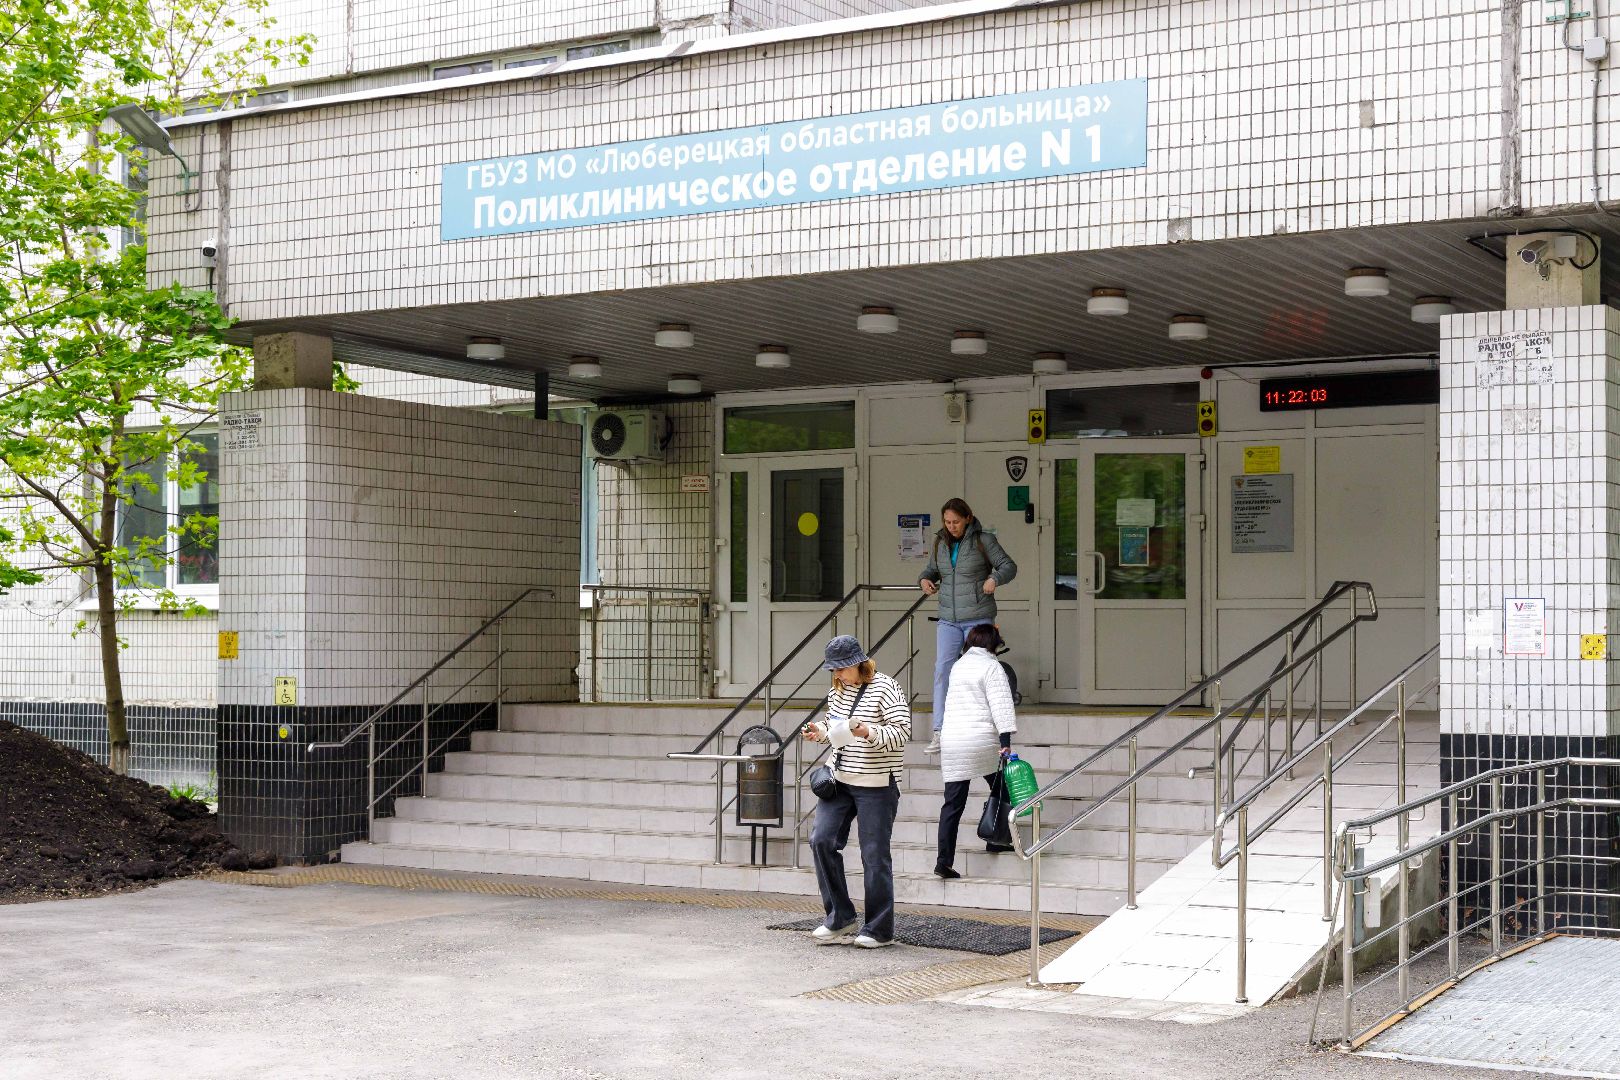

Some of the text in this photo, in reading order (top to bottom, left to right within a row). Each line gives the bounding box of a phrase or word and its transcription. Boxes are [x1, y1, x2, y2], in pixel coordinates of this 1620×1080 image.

[467, 94, 1111, 190] ГБУЗ МО «Люберецкая областная больница»
[473, 124, 1101, 229] Поликлиническое отделение N 1
